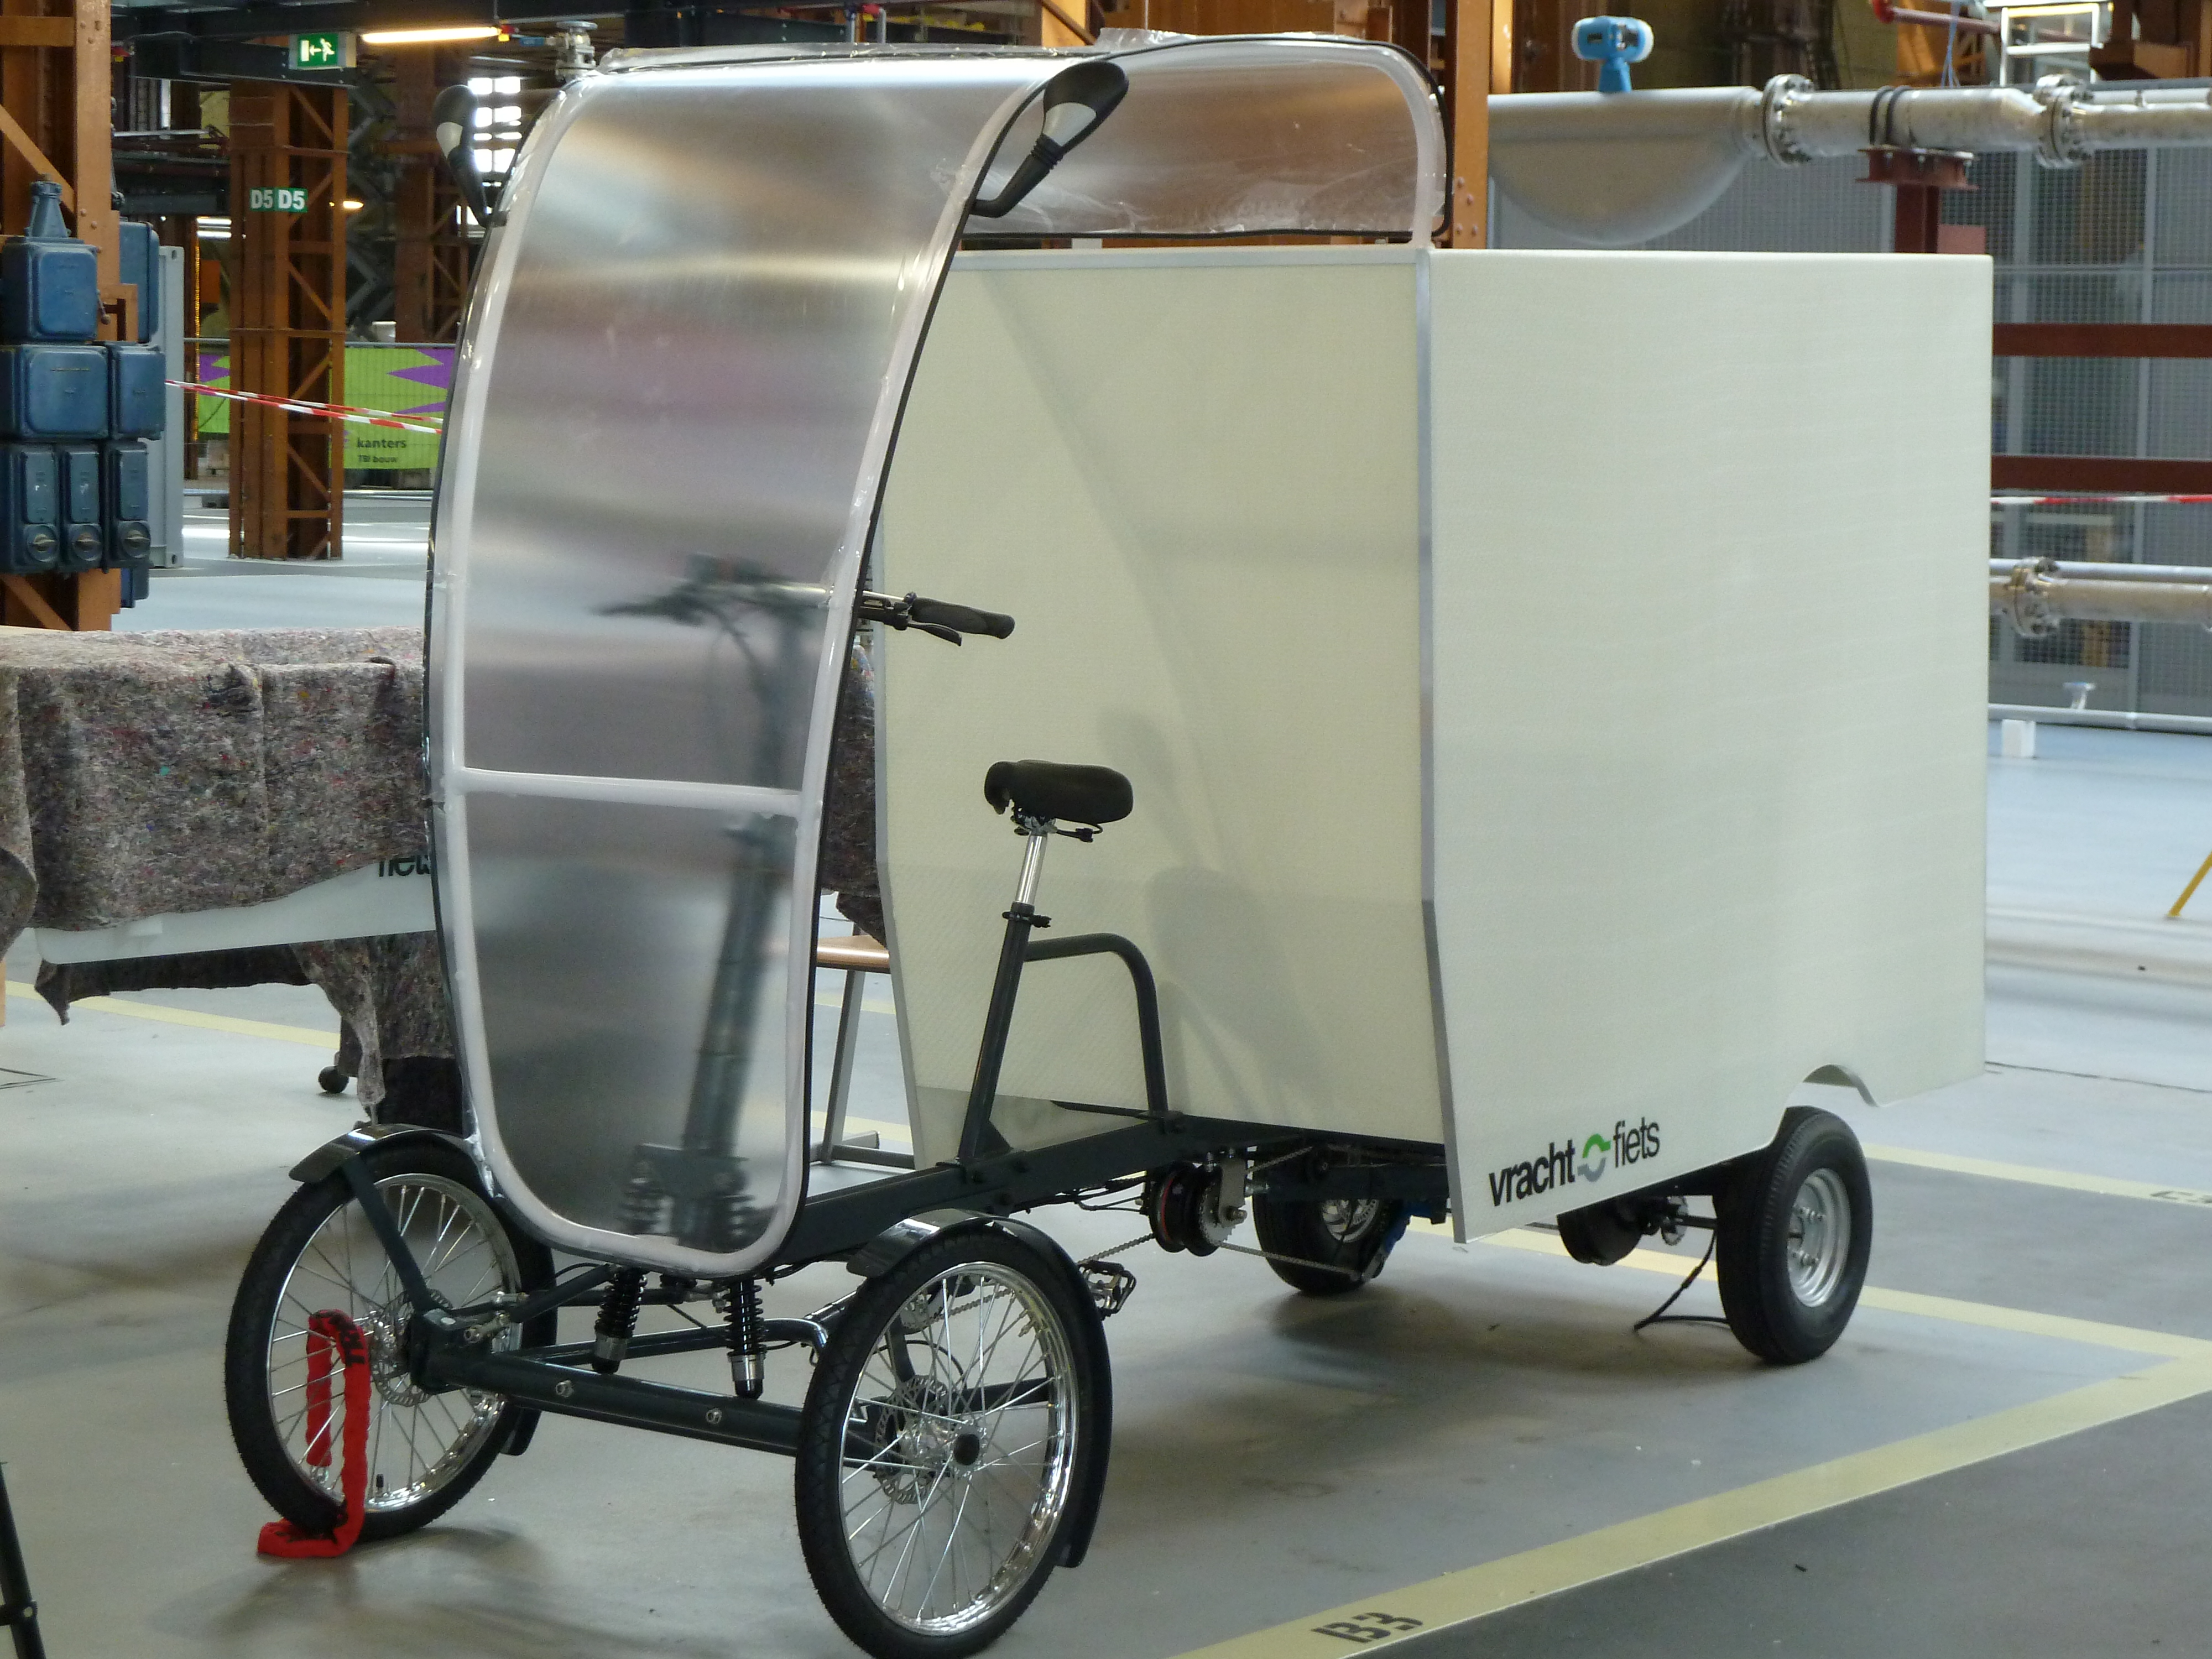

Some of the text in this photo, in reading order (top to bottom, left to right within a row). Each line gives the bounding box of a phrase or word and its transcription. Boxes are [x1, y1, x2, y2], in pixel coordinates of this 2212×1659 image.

[251, 189, 305, 210] D5 D5
[357, 437, 407, 448] kanters
[1489, 1117, 1660, 1207] vracht fiets
[1310, 1611, 1423, 1644] B3
